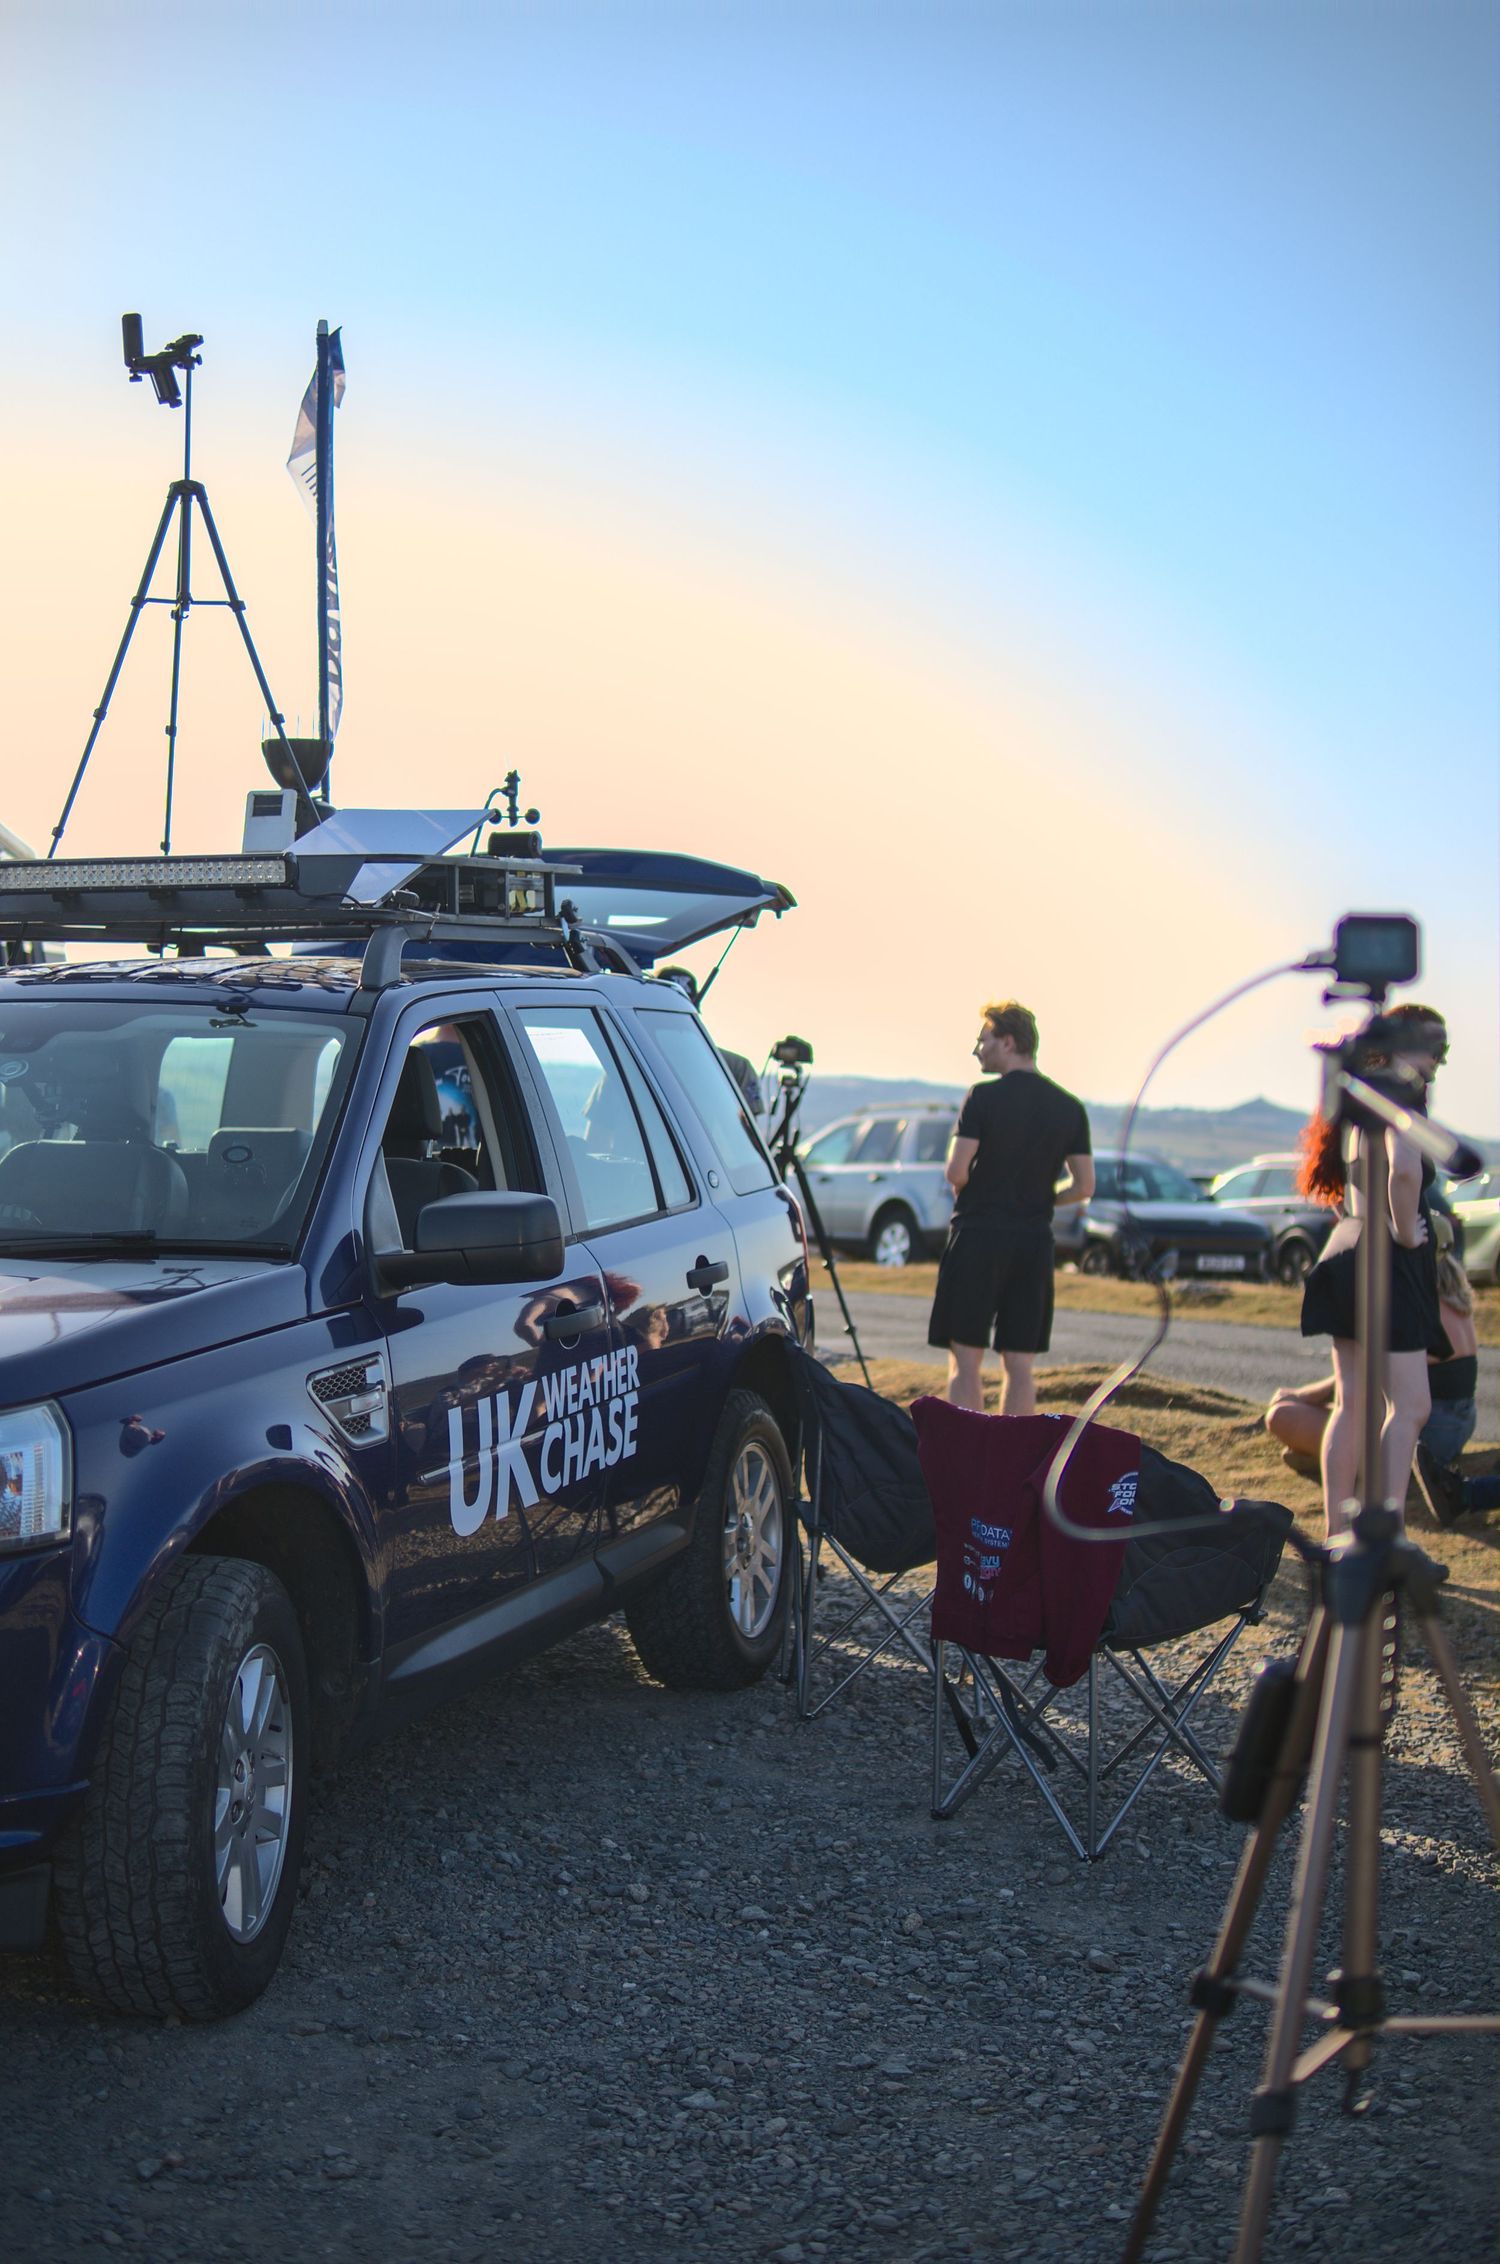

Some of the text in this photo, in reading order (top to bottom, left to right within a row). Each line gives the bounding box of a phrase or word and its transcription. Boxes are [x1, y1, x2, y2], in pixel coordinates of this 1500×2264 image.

[541, 1345, 640, 1422] WEATHER
[448, 1380, 540, 1537] UK
[540, 1391, 639, 1494] CHASE
